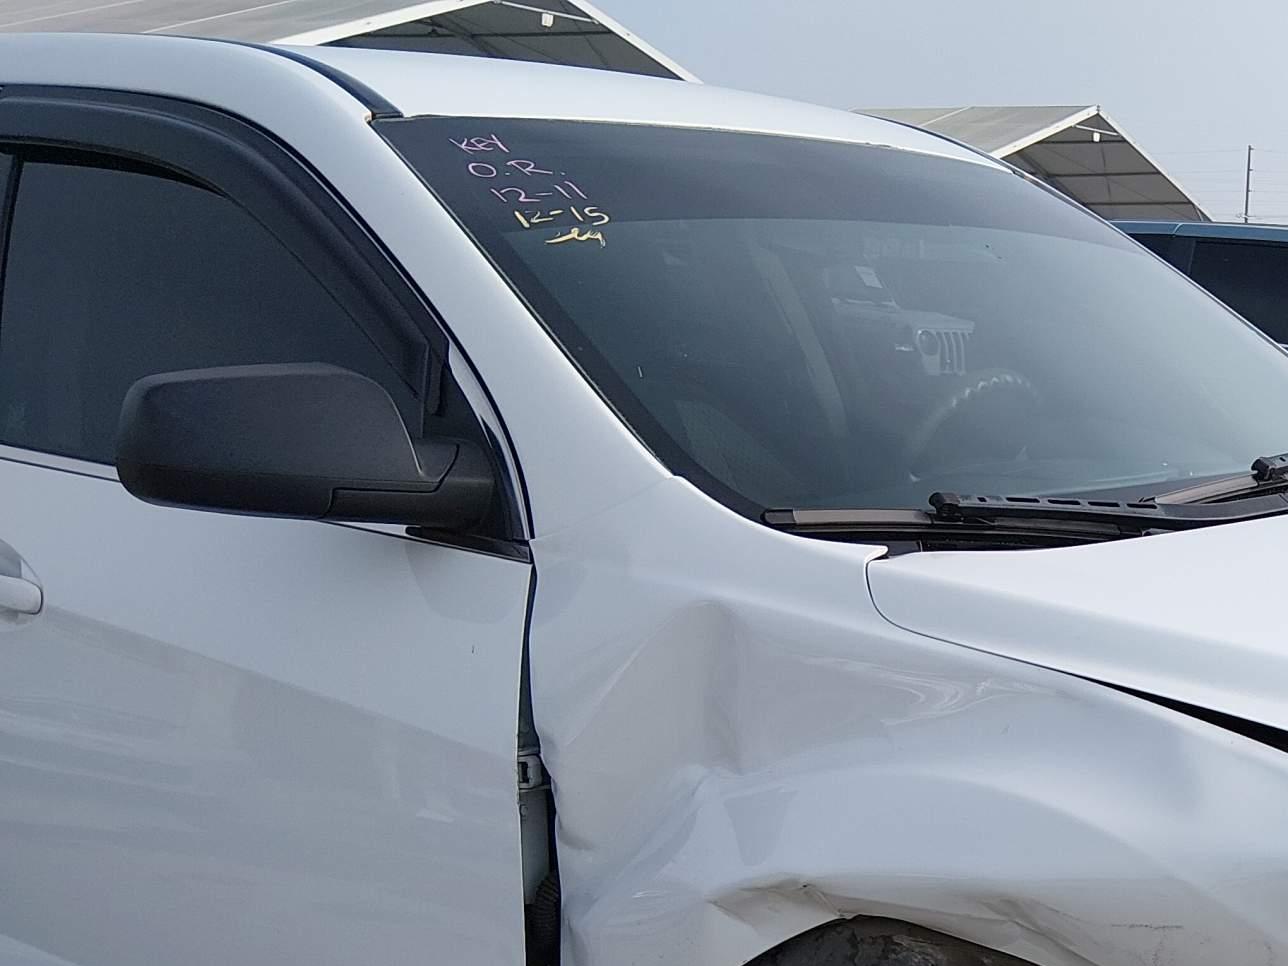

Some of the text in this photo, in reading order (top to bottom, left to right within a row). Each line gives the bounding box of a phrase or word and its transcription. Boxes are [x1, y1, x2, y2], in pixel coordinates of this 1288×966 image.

[449, 134, 510, 154] KEY
[490, 181, 588, 202] 12-11
[514, 206, 610, 228] 12-15
